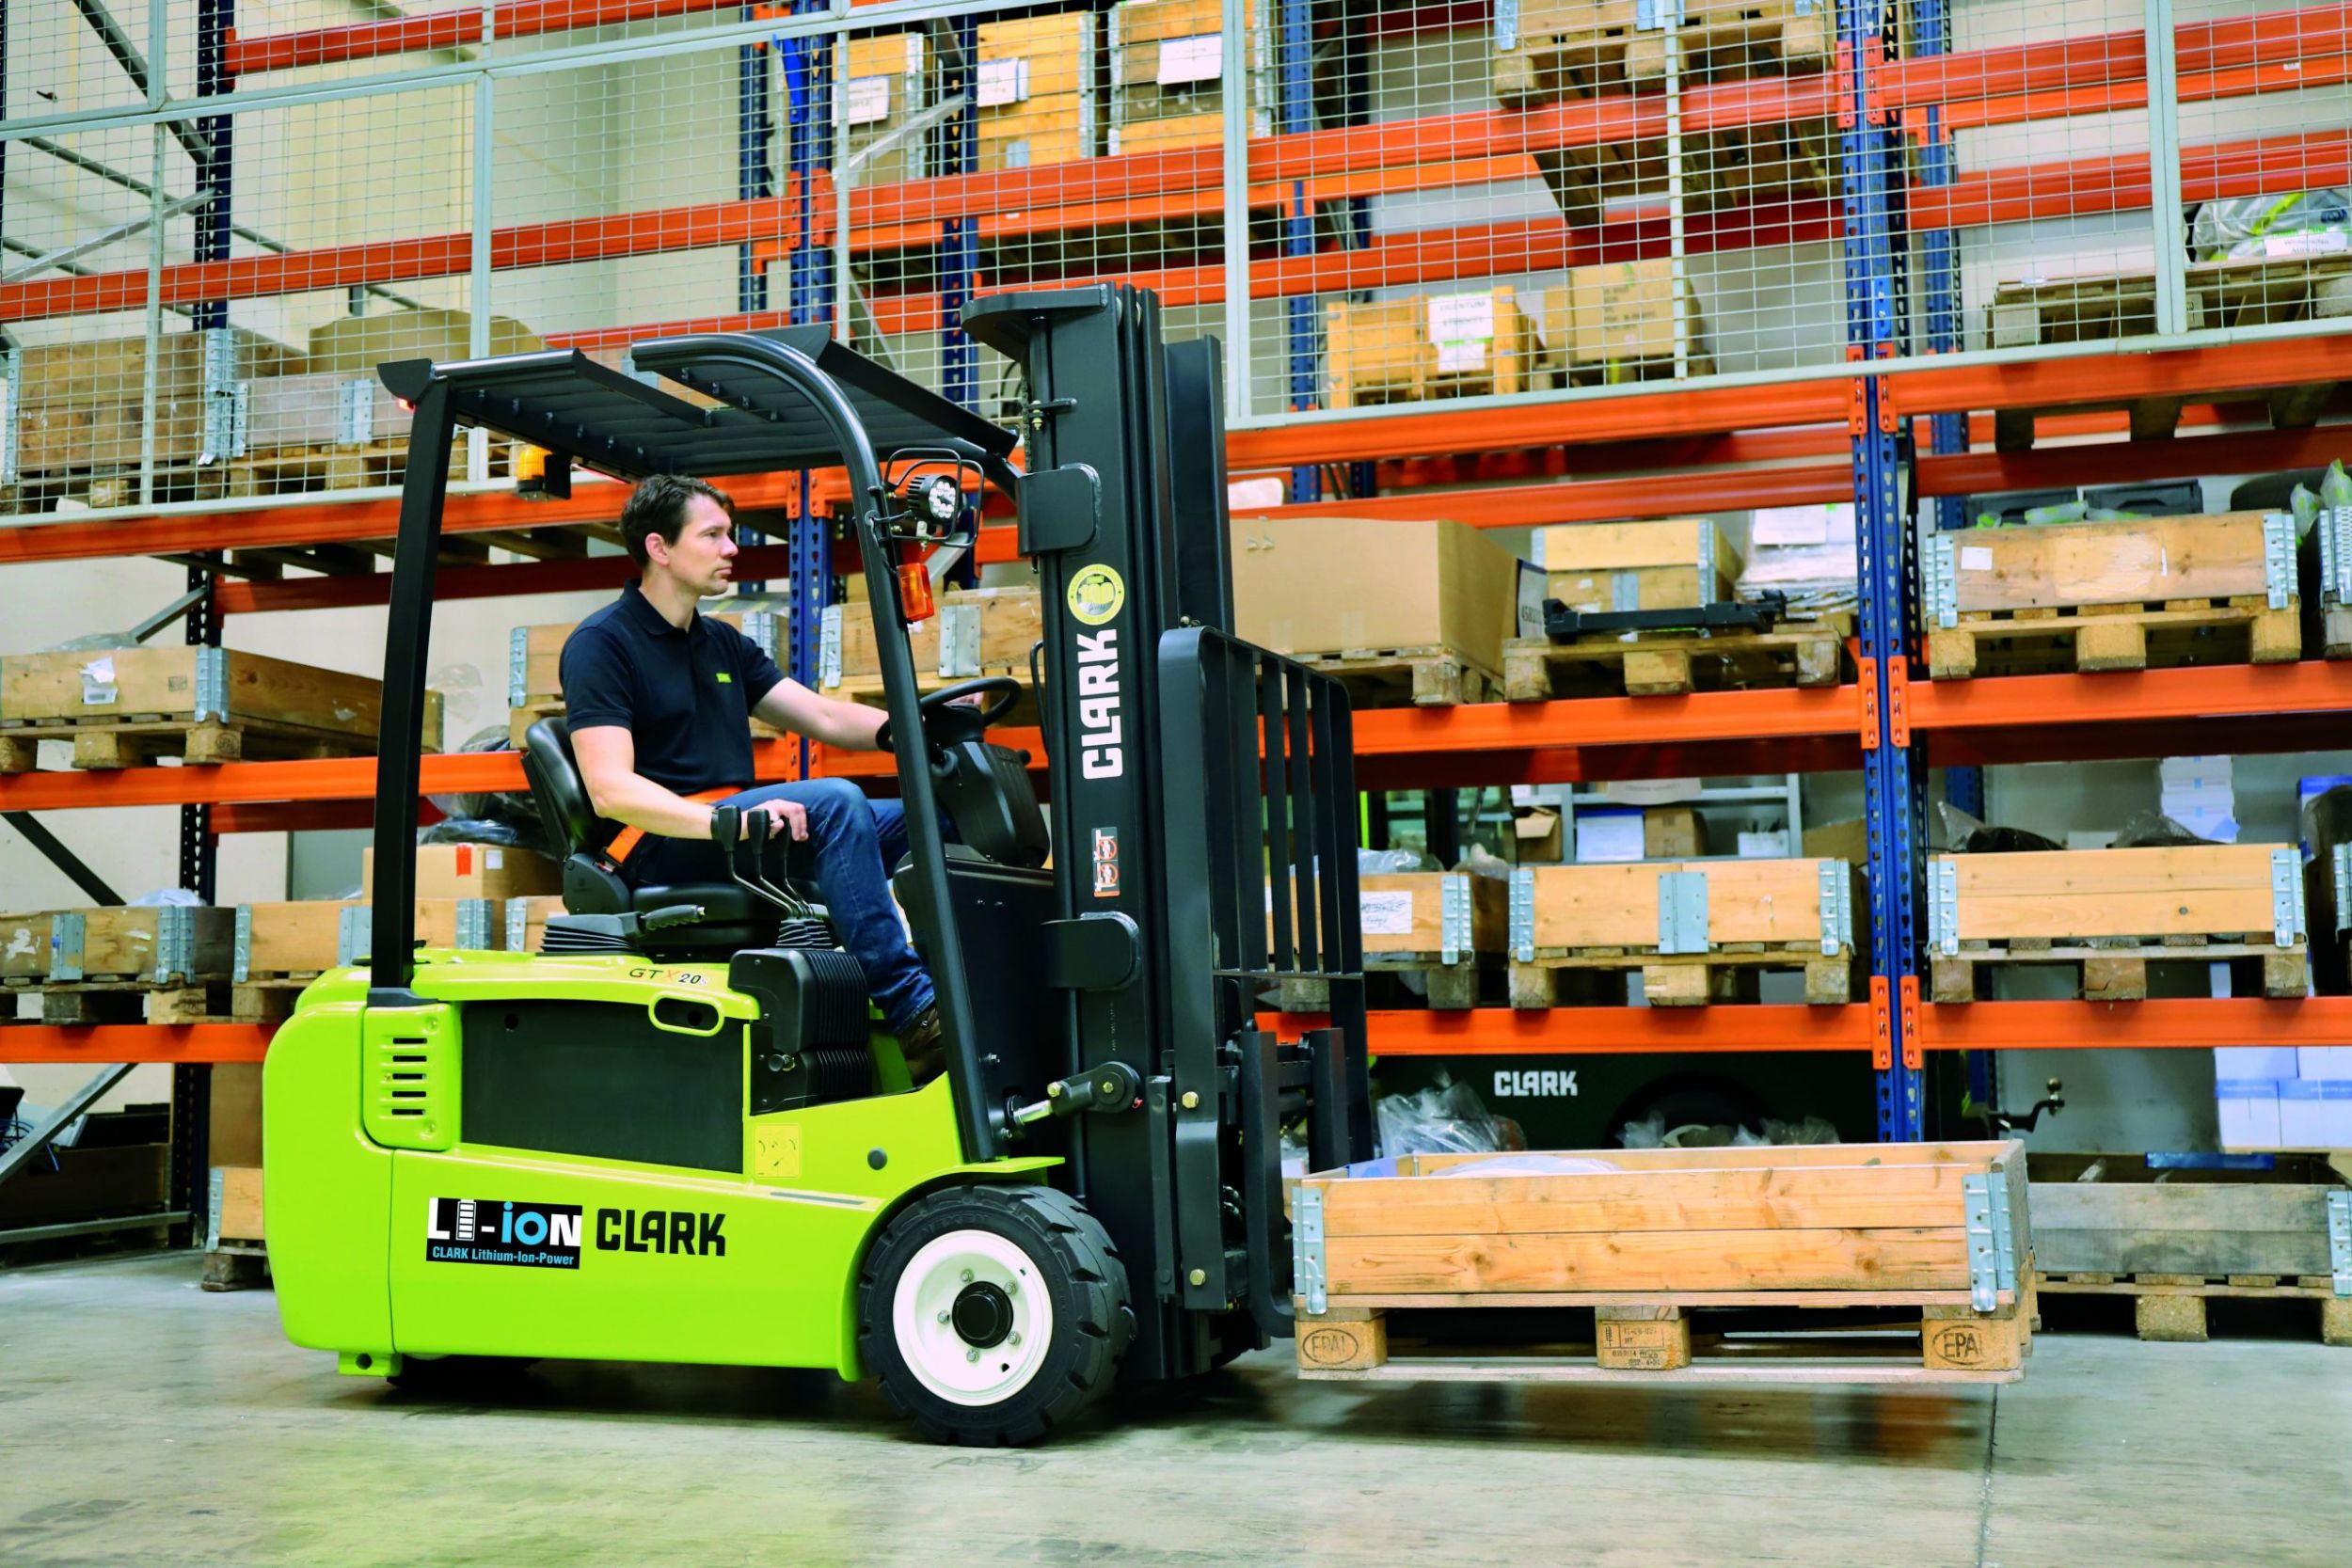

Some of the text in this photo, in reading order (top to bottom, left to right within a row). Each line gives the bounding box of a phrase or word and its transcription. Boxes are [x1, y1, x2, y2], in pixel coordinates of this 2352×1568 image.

[1076, 628, 1123, 780] CLARK
[1494, 1070, 1579, 1097] CLARK
[596, 1208, 726, 1257] CLARK
[432, 1245, 575, 1266] CLARK Lithium-Ion-Power
